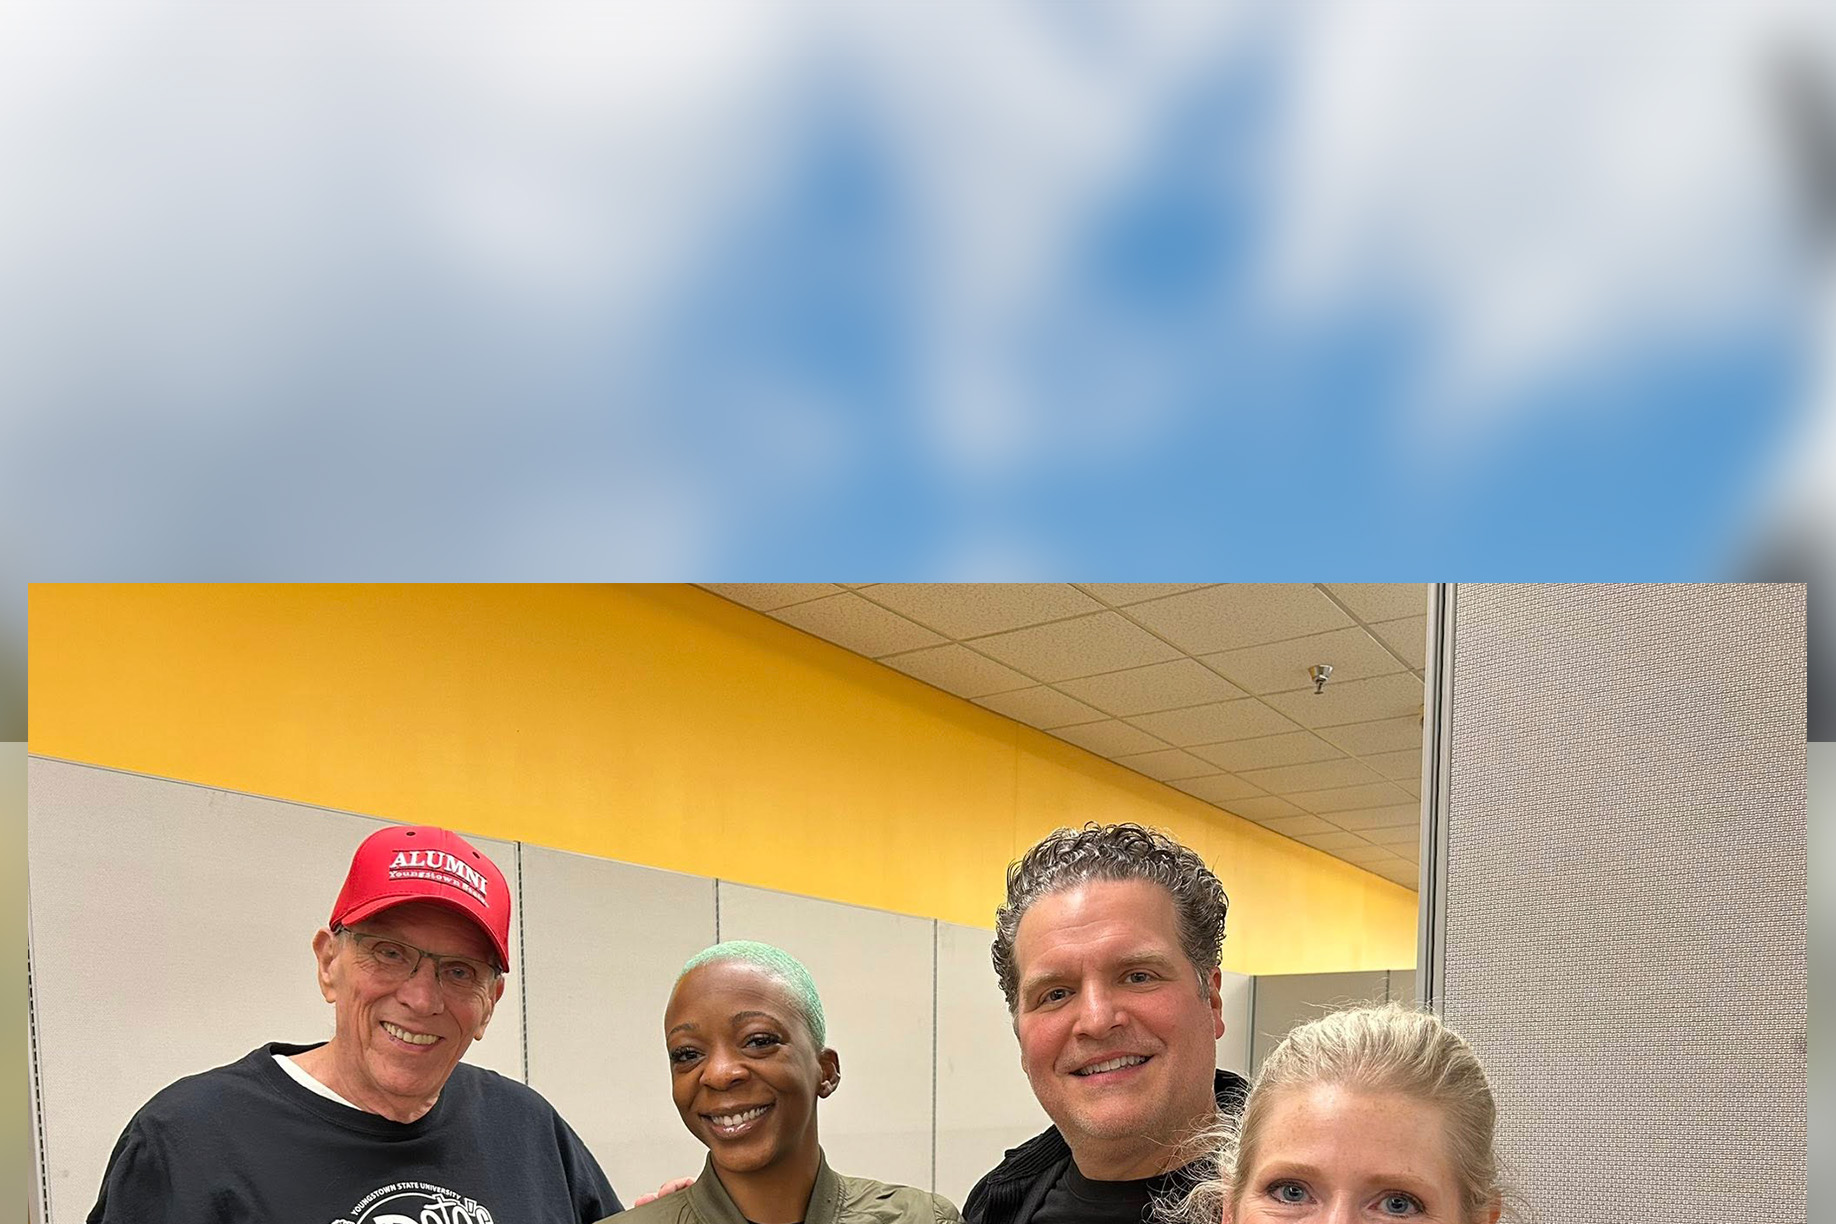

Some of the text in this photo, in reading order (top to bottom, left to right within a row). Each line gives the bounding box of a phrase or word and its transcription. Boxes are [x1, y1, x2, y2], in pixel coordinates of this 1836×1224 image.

[389, 851, 488, 896] ALUMNI
[351, 1182, 461, 1216] YOUNGSTOWN STATE UNIVERSITY
